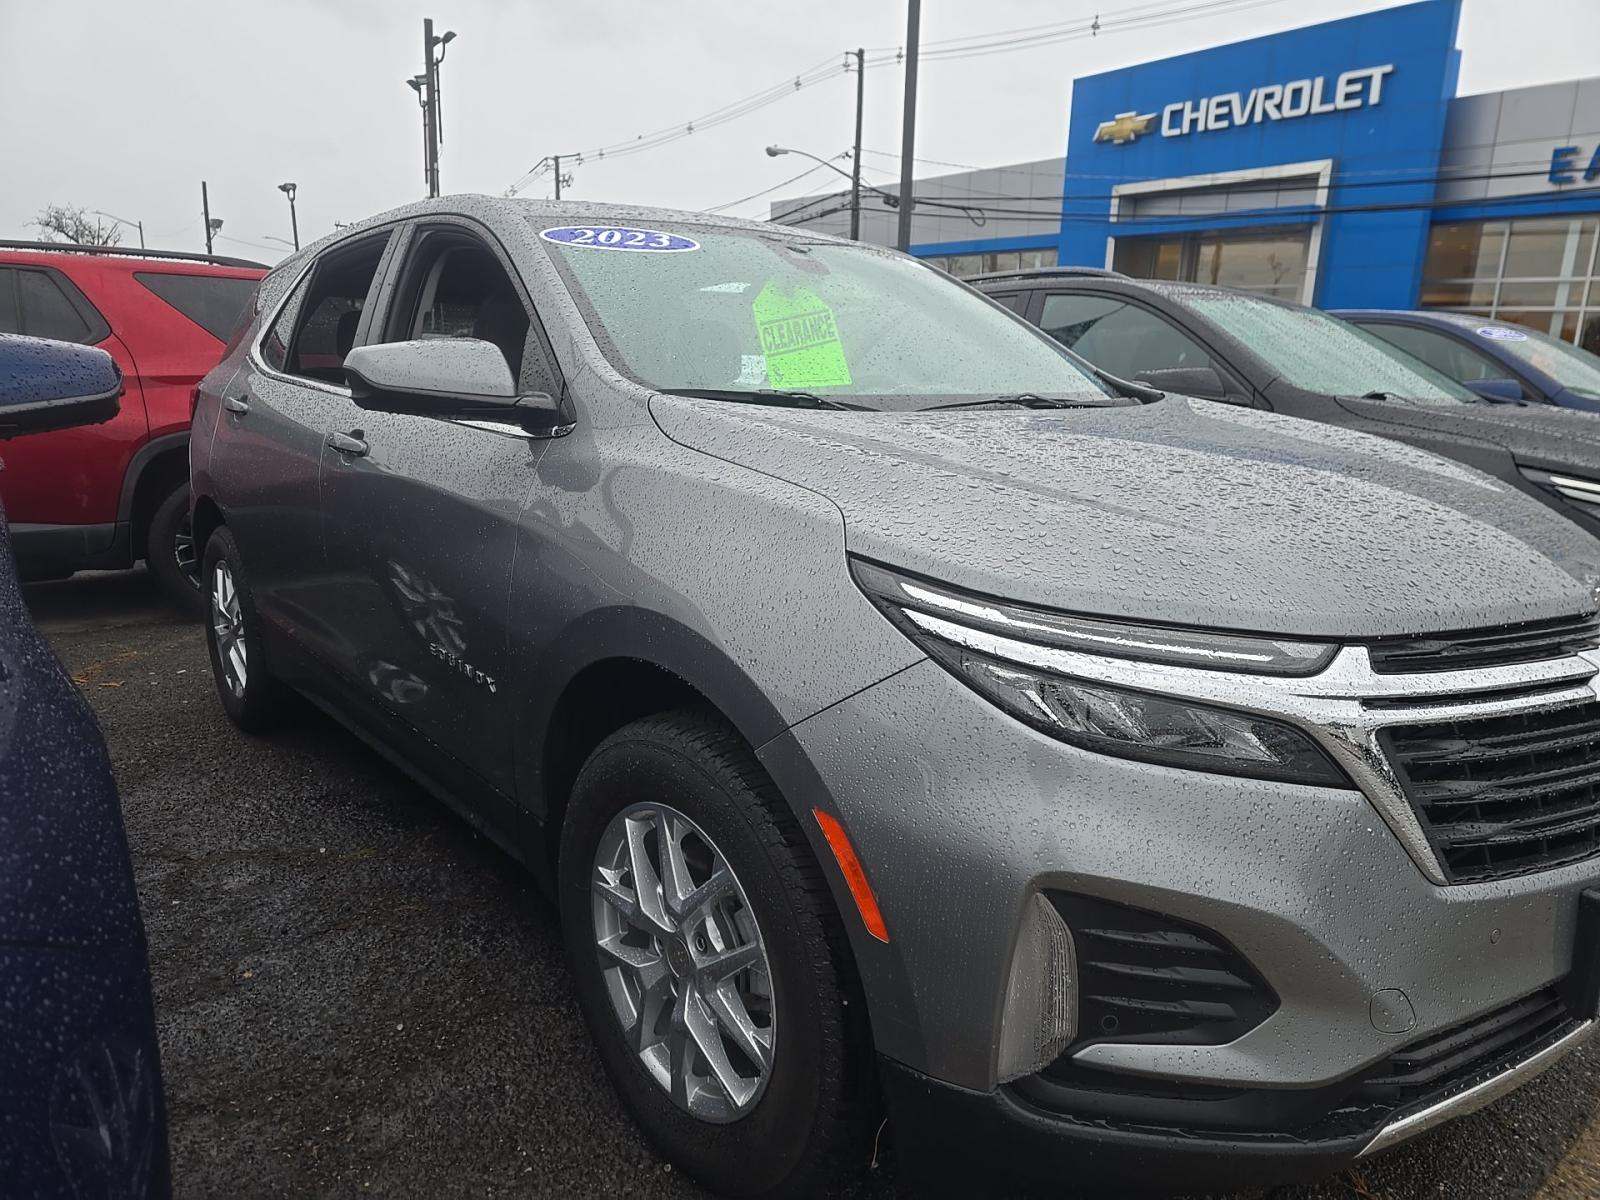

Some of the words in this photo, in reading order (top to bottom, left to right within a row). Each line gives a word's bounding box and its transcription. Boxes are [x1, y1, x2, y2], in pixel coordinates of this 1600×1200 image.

[1161, 64, 1394, 138] CHEVROLET
[571, 229, 671, 248] 2023
[762, 312, 837, 353] CLEARANCE
